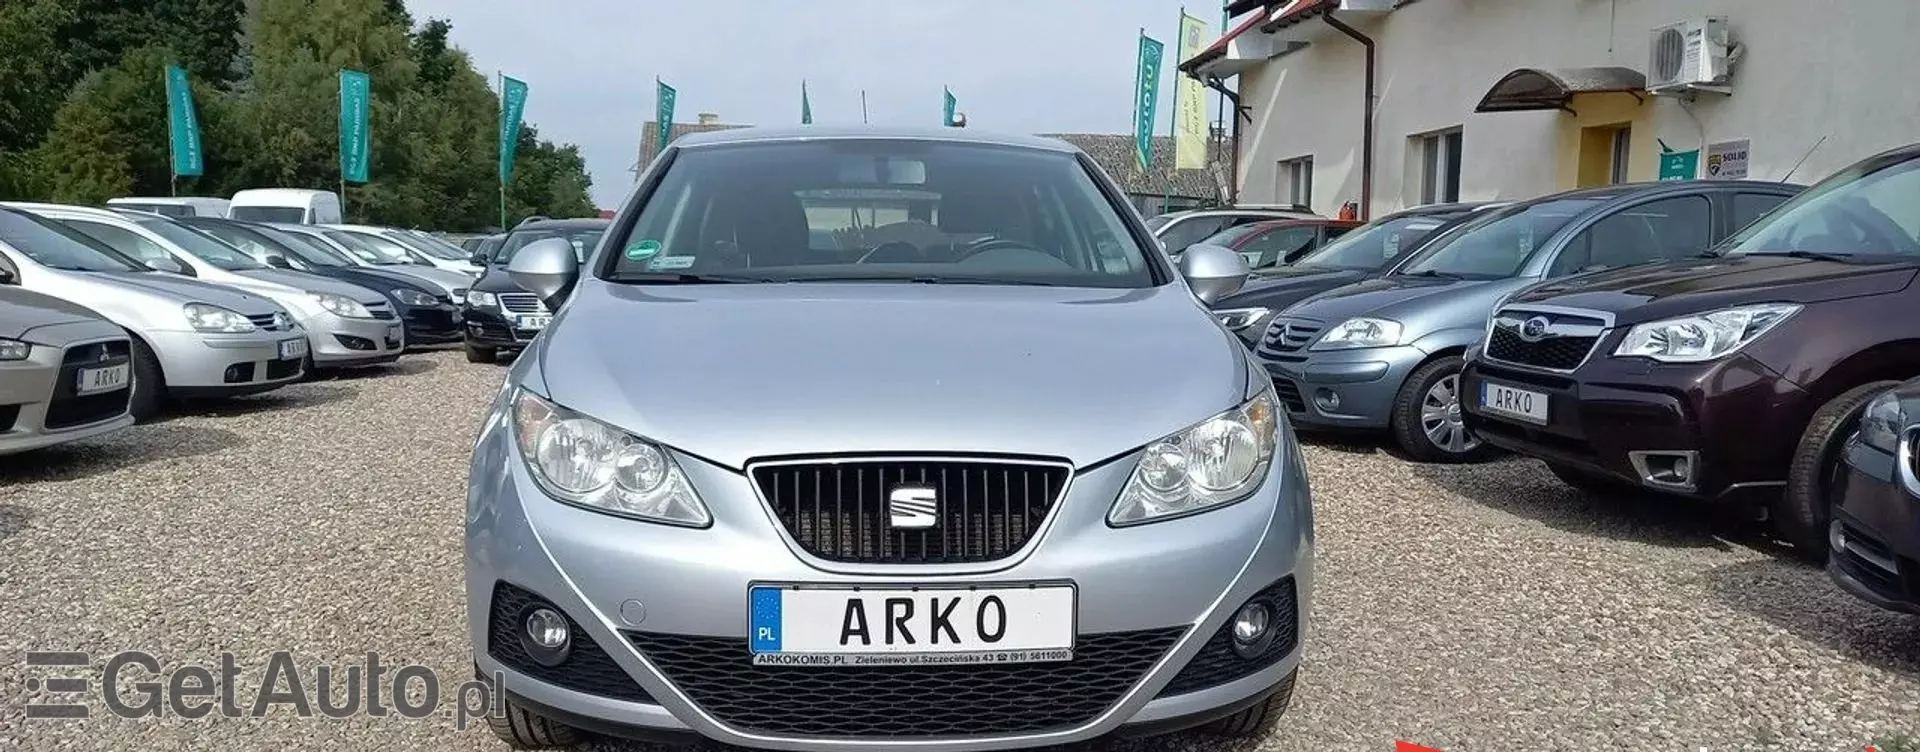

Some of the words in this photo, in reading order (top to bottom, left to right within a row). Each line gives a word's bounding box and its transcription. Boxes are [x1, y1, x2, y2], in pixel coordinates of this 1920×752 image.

[1723, 151, 1747, 162] SOLID
[94, 367, 121, 387] ARKO
[1495, 388, 1533, 413] ARKO
[839, 595, 1007, 645] ARKO
[758, 627, 776, 641] PL
[758, 654, 849, 665] ARKOKOMIS.PL
[855, 653, 907, 665] Zieleniewo
[982, 653, 994, 662] 43
[1010, 652, 1027, 662] (91)
[1030, 650, 1068, 661] 5611000
